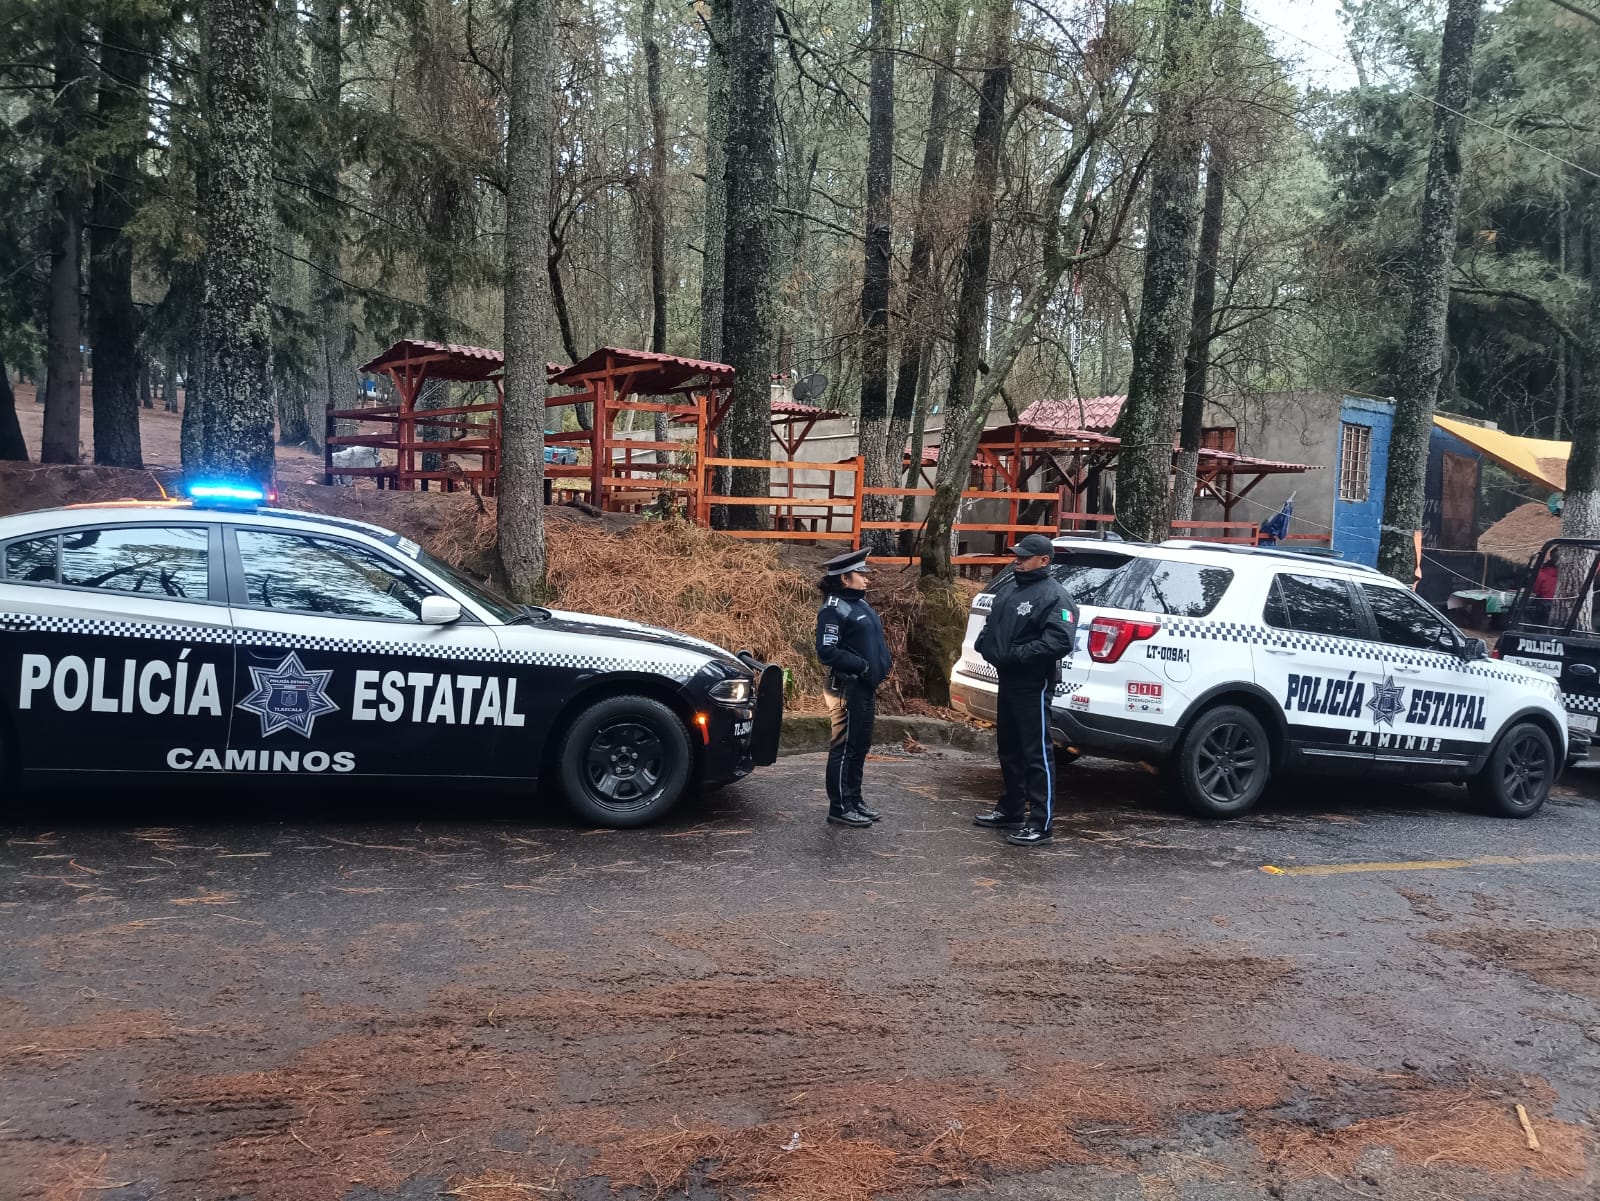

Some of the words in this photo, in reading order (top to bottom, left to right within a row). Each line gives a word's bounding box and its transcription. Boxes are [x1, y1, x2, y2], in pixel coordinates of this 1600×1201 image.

[1517, 638, 1564, 656] POLICÍA
[1515, 659, 1559, 671] TLAXCALA
[19, 648, 222, 716] POLICÍA
[352, 669, 525, 727] ESTATAL
[1129, 684, 1161, 695] 911
[1284, 670, 1365, 718] POLICÍA
[1405, 689, 1487, 730] ESTATAL
[1348, 730, 1442, 752] CAMINOS
[166, 747, 356, 772] CAMINOS
